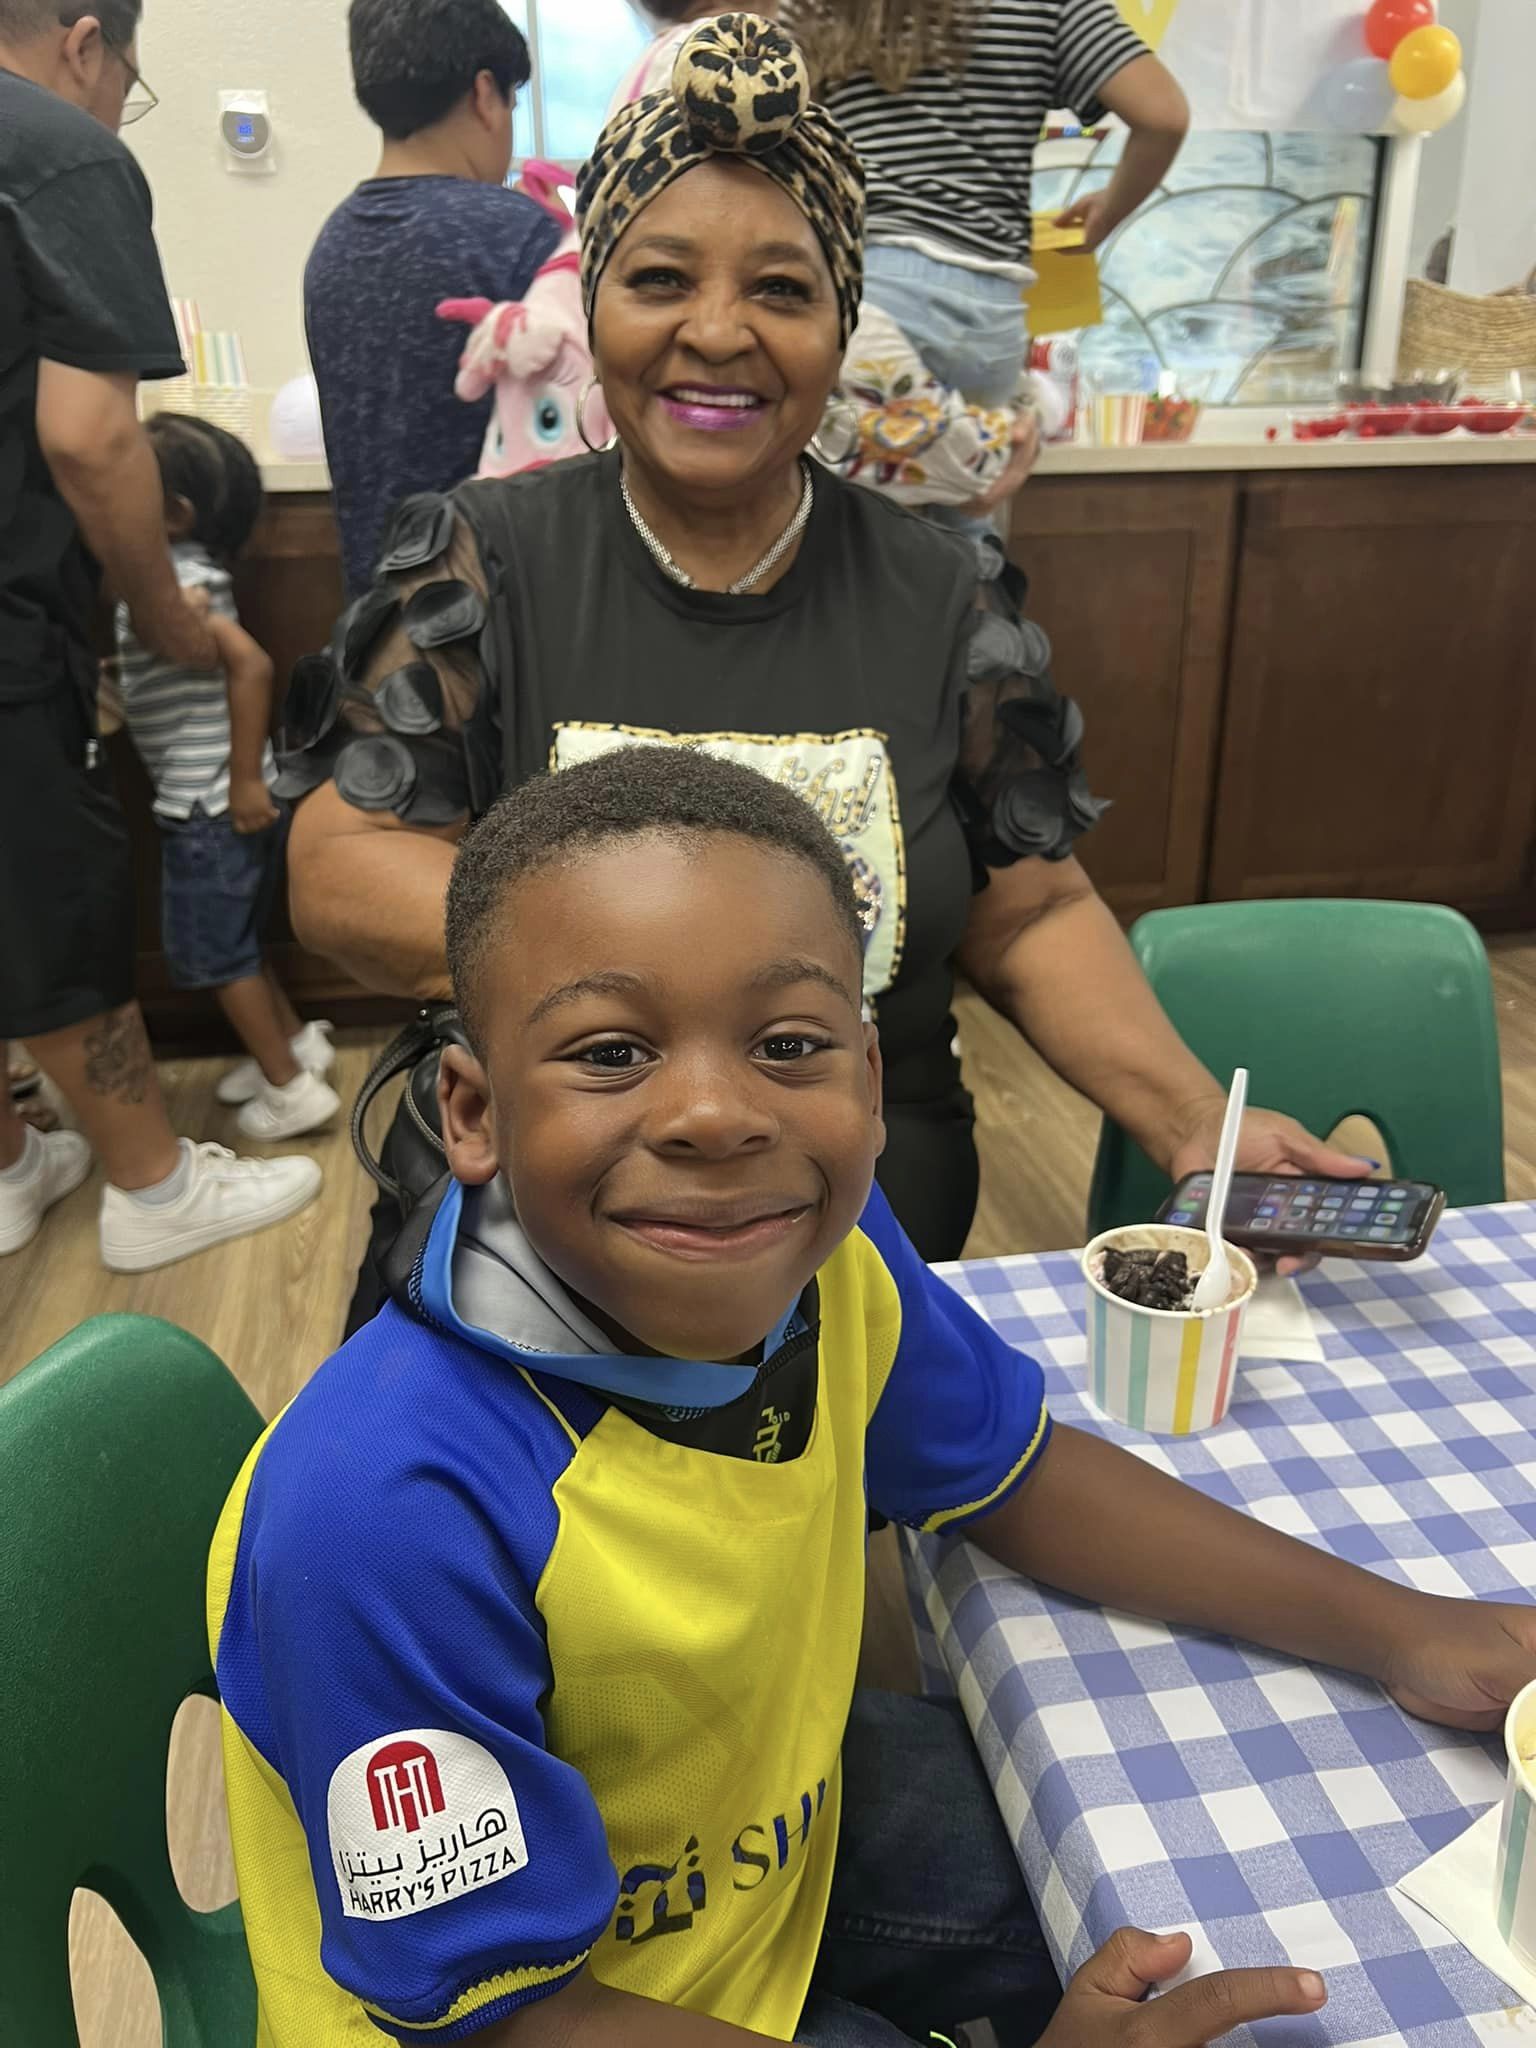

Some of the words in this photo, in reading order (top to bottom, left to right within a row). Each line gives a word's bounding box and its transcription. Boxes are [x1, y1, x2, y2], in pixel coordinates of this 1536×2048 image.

[338, 1850, 404, 1886] بيتزا
[416, 1808, 508, 1875] هاريز
[349, 1876, 435, 1914] HARRY'S
[441, 1846, 517, 1894] PIZZA
